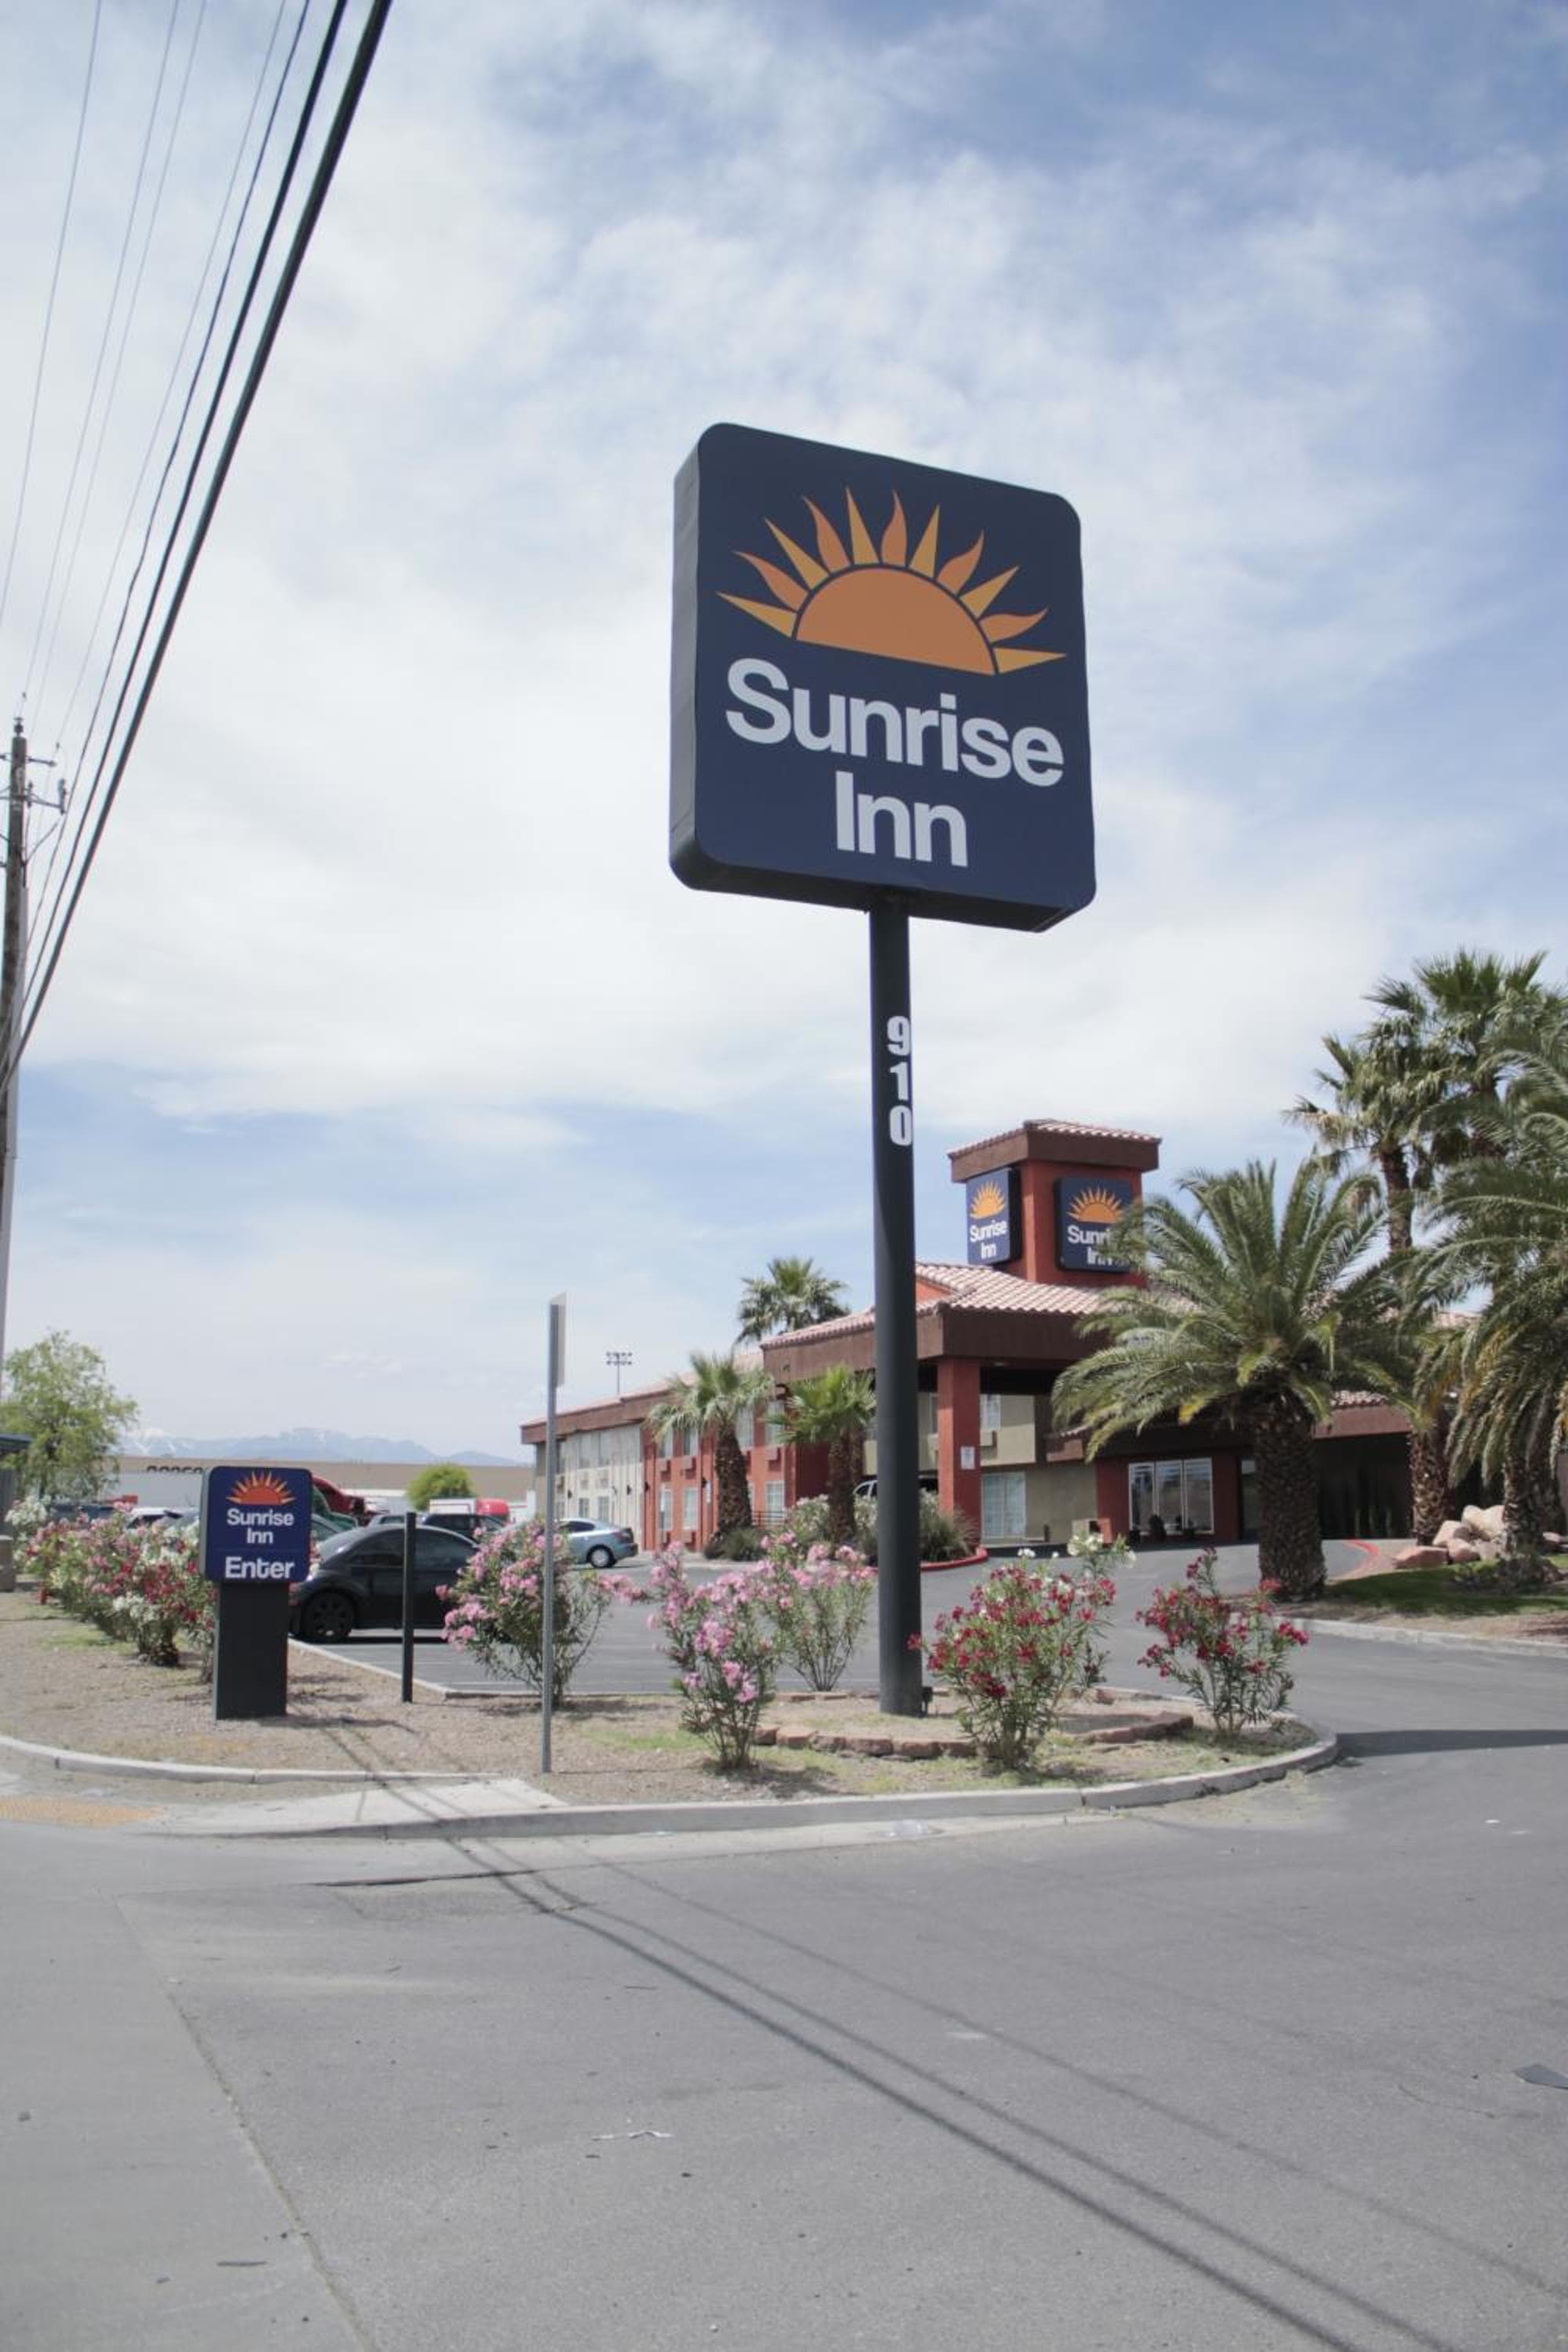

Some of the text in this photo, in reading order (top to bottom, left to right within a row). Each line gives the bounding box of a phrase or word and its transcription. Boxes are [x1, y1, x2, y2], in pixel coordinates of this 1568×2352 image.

[725, 658, 1065, 787] Sunrise
[835, 770, 968, 868] Inn
[887, 1015, 913, 1146] 910
[970, 1219, 1007, 1243] Sunrise
[1067, 1225, 1113, 1247] Sunri
[981, 1243, 996, 1259] Inn
[226, 1508, 295, 1526] Sunrise
[246, 1527, 274, 1544] Inn
[225, 1556, 296, 1579] Enter
